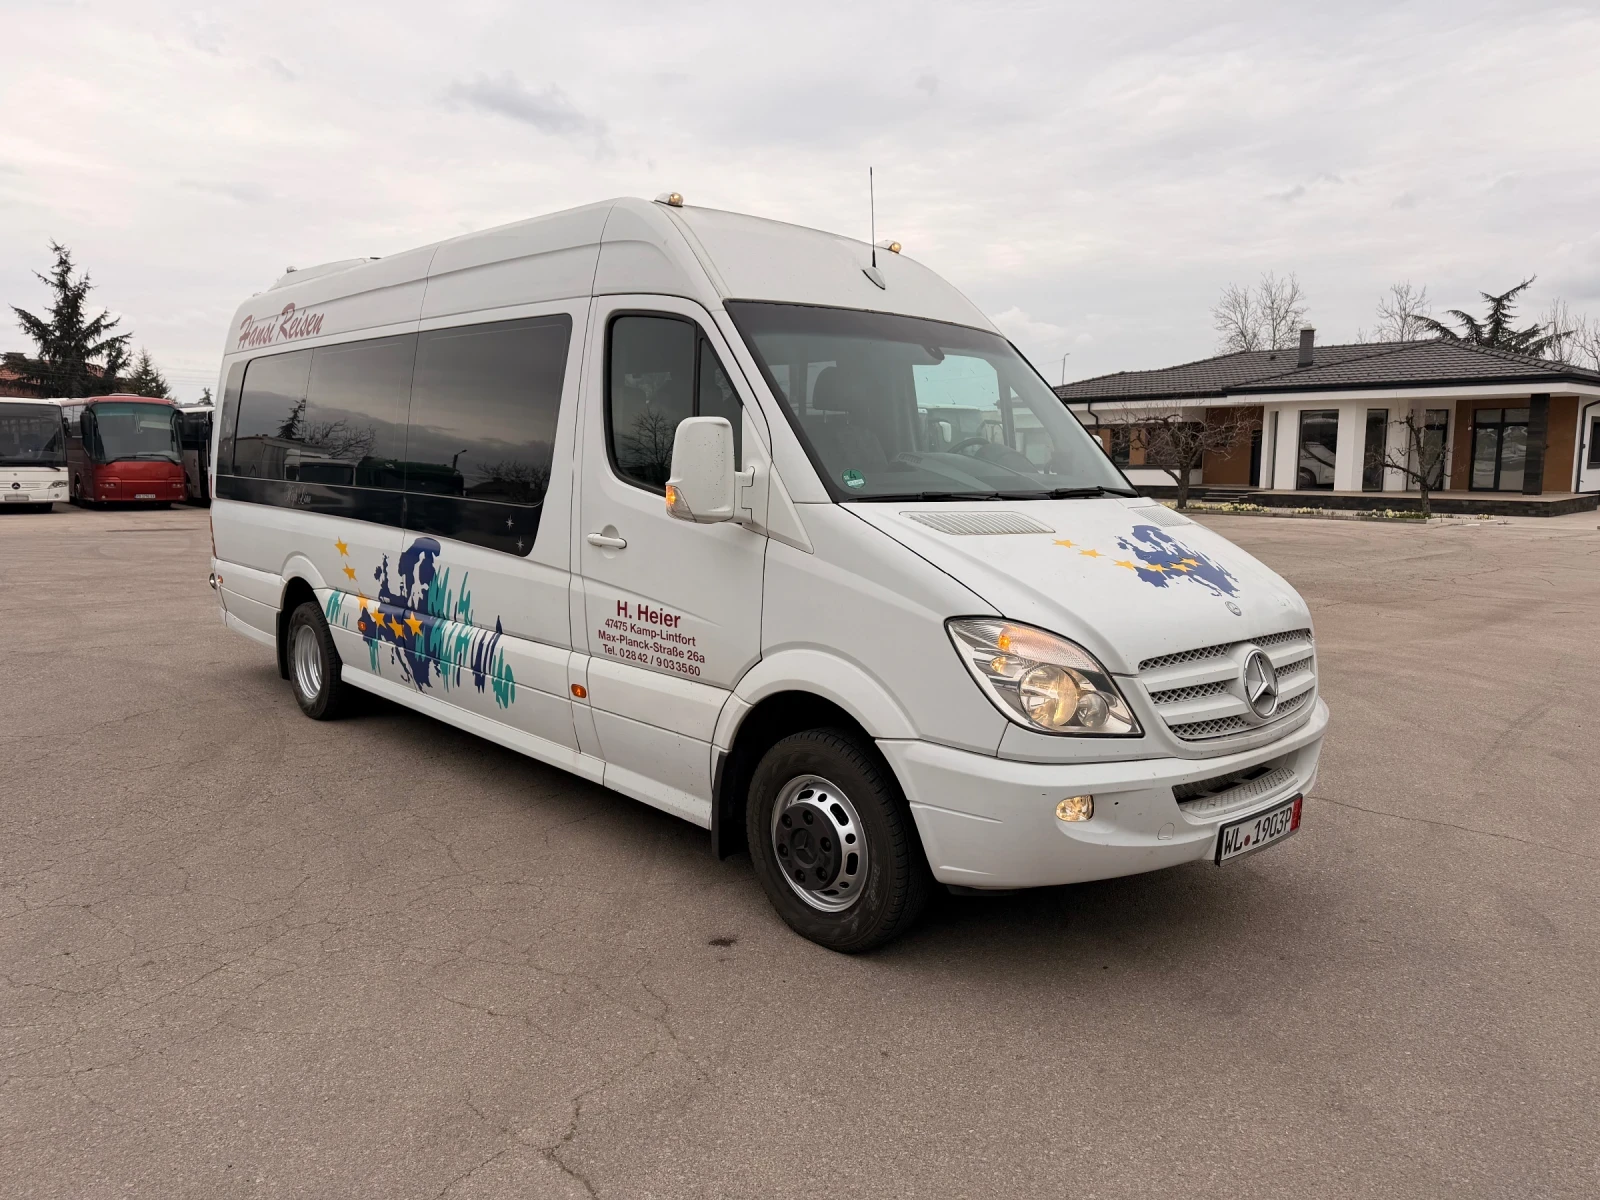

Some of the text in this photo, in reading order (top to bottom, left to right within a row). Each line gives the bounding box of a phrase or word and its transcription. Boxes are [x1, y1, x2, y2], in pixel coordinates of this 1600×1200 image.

[237, 302, 325, 350] Hansi Reisen
[616, 599, 681, 628] H. Heier
[598, 629, 705, 663] Max-Planck-Straße 26a
[604, 618, 696, 647] 47475 Kamp-Lintfort
[602, 643, 618, 656] Tel.
